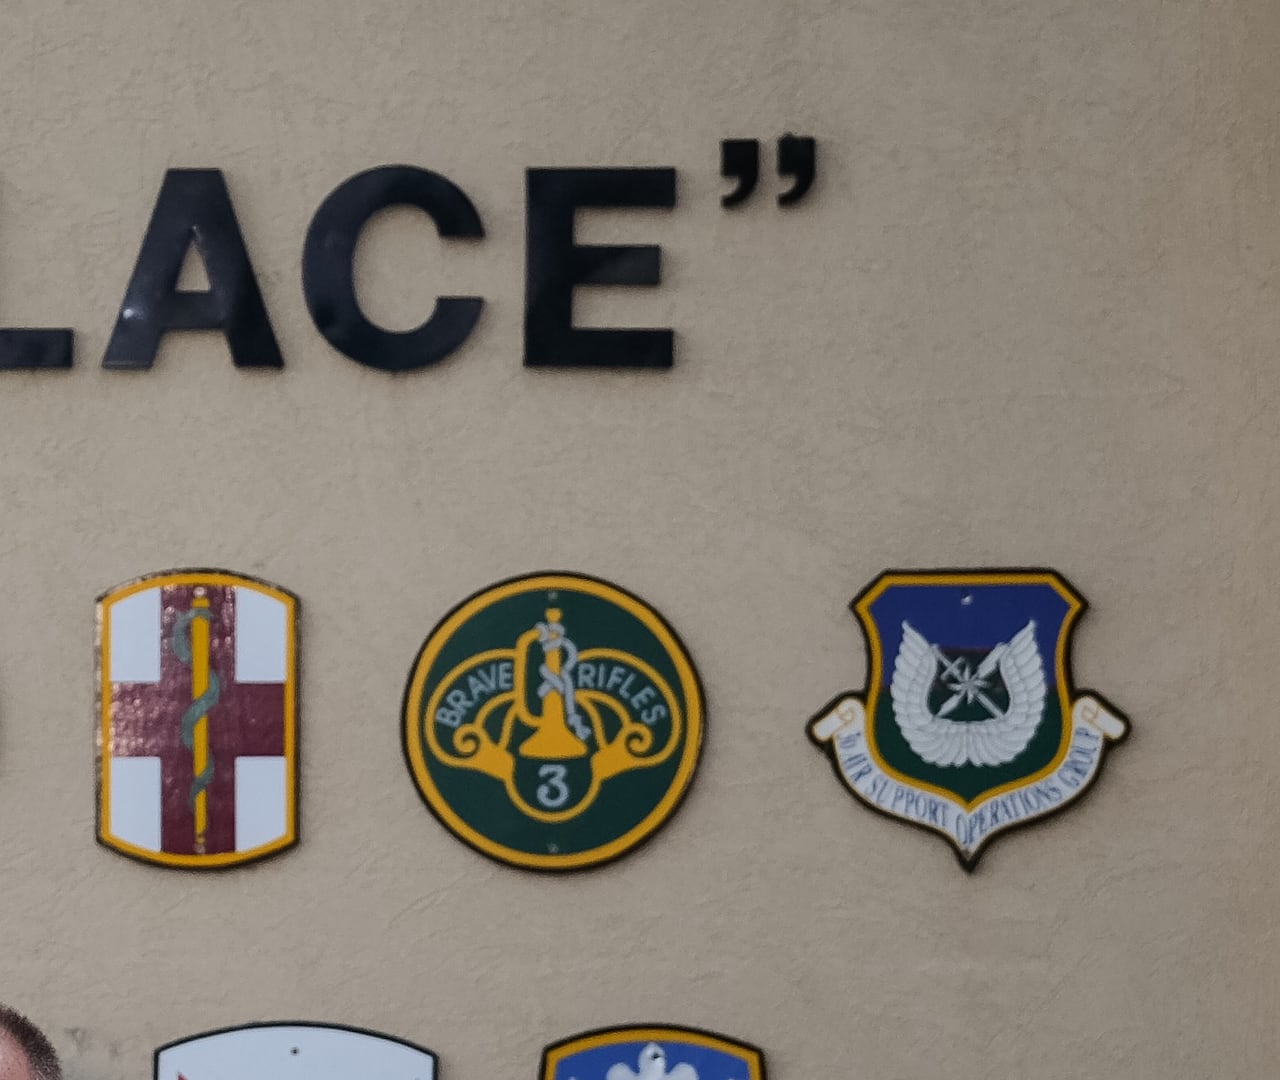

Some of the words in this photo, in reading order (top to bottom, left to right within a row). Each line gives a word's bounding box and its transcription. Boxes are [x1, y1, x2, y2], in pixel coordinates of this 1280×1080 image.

[435, 662, 515, 728] BRAVE
[577, 662, 667, 727] RIFLES
[536, 764, 570, 808] 3
[864, 774, 949, 827] SUPPORT
[955, 783, 1062, 845] OPERATIONS
